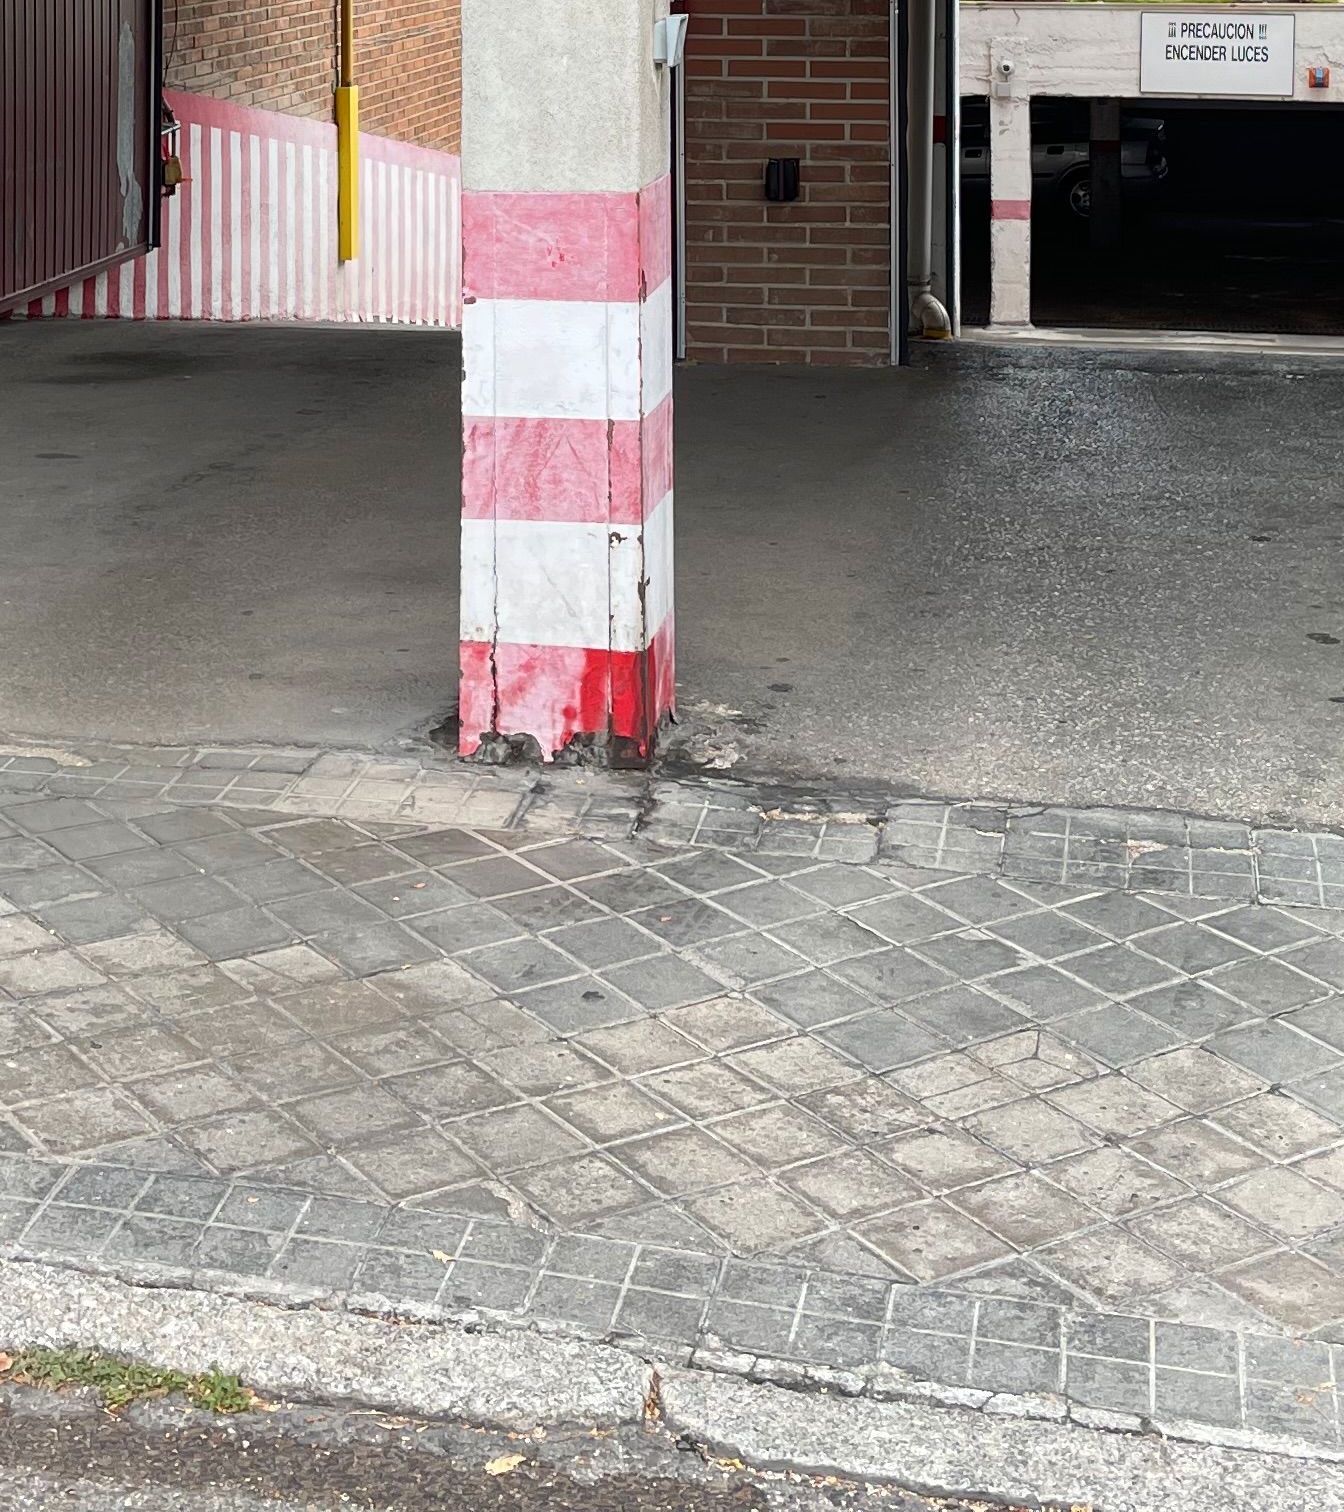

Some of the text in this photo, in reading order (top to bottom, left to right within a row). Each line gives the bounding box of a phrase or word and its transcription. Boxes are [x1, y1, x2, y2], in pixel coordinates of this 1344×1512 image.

[1181, 22, 1255, 40] PRECAUCION
[1165, 44, 1269, 63] ENCENDER LUCES
